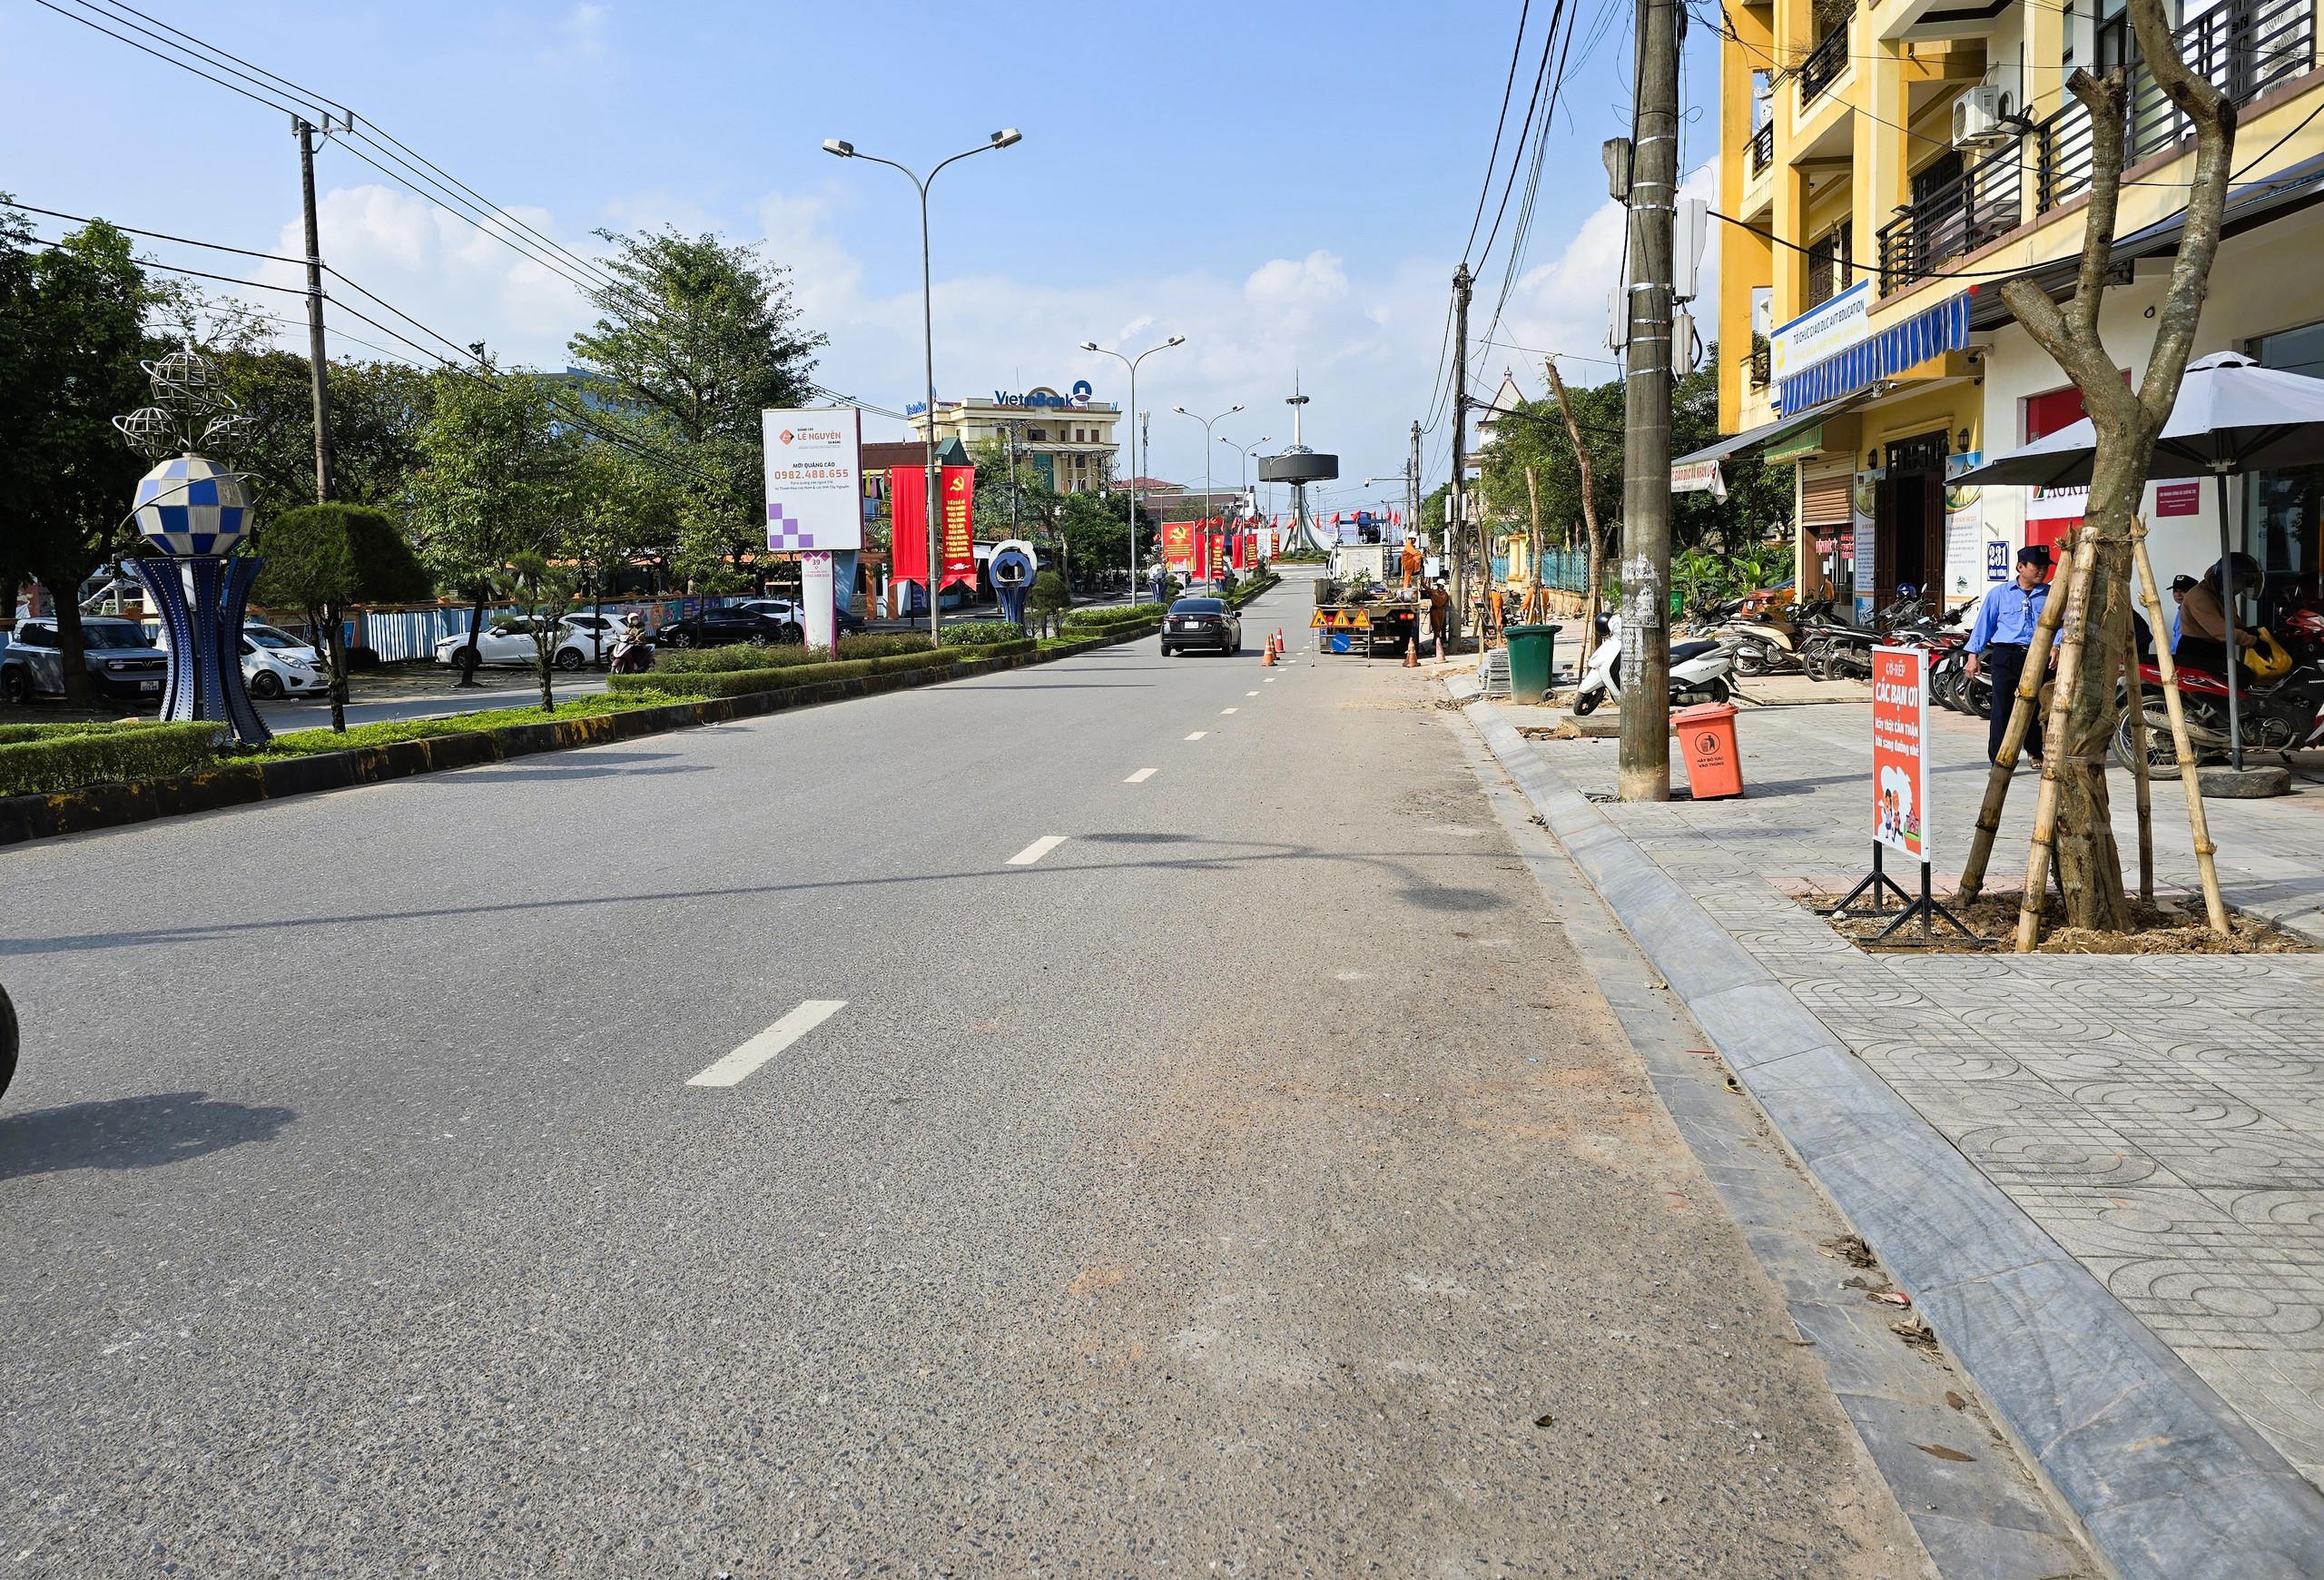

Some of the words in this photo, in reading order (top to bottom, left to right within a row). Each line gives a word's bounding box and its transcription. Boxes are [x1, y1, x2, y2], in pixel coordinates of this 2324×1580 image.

[1839, 299, 1864, 322] EDUCATION
[995, 390, 1077, 410] VietinBank
[798, 432, 807, 440] LÊ
[809, 430, 841, 440] NGUYỄN
[775, 469, 849, 479] 0982.488.655
[1989, 545, 2007, 566] 231
[1876, 676, 1890, 703] CÁC
[1891, 684, 1907, 711] BẠN
[1905, 722, 1918, 739] THẬN
[1883, 739, 1894, 752] sang
[1894, 739, 1909, 756] đường
[1910, 744, 1919, 757] nhé
